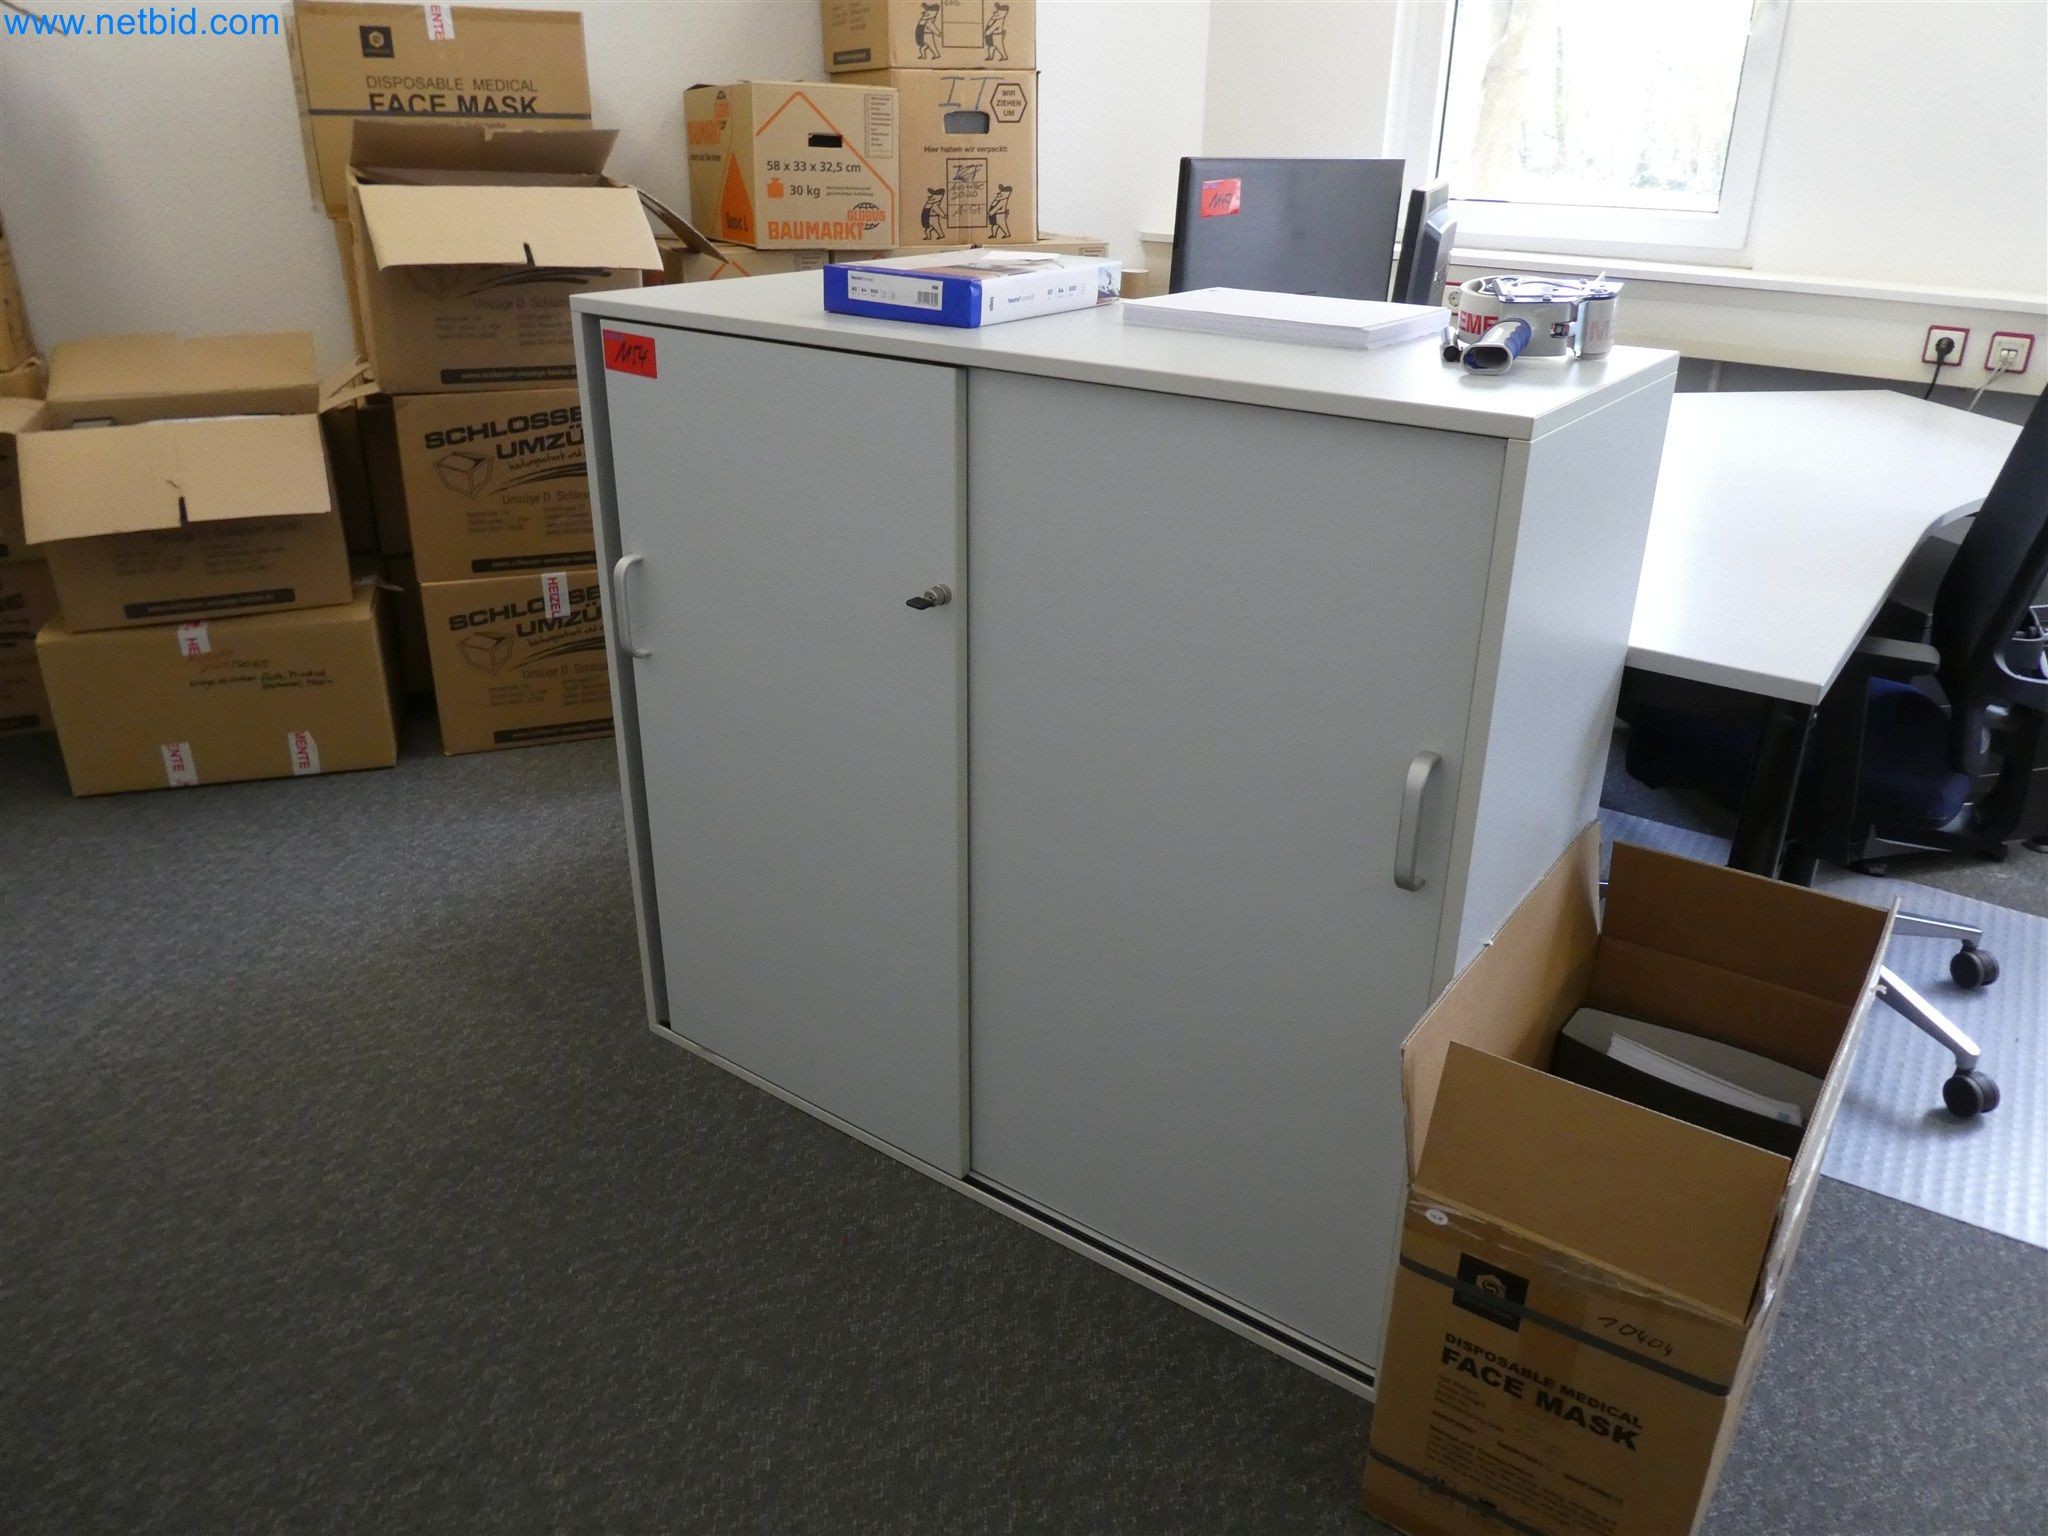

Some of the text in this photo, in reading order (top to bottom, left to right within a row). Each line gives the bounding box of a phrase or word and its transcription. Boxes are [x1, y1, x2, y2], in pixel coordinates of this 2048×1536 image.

[366, 75, 538, 92] DISPOSABLE MEDICAL
[1001, 89, 1016, 97] WIR
[368, 93, 538, 113] FACE MASK
[996, 99, 1021, 107] ZIEHEN
[1003, 109, 1015, 117] UM
[924, 145, 939, 153] Hier
[940, 145, 962, 153] haben
[964, 145, 975, 153] wir
[767, 160, 861, 173] 58 x 33 x 32,5 cm
[790, 185, 803, 196] 30
[807, 184, 821, 198] kg
[847, 209, 886, 222] GLOBUS
[768, 221, 865, 240] BAUMARKT
[1444, 1332, 1555, 1390] DISPOSABLE
[1560, 1385, 1644, 1430] MEDICAL
[1440, 1346, 1526, 1400] FACE
[1535, 1389, 1640, 1452] MASK
